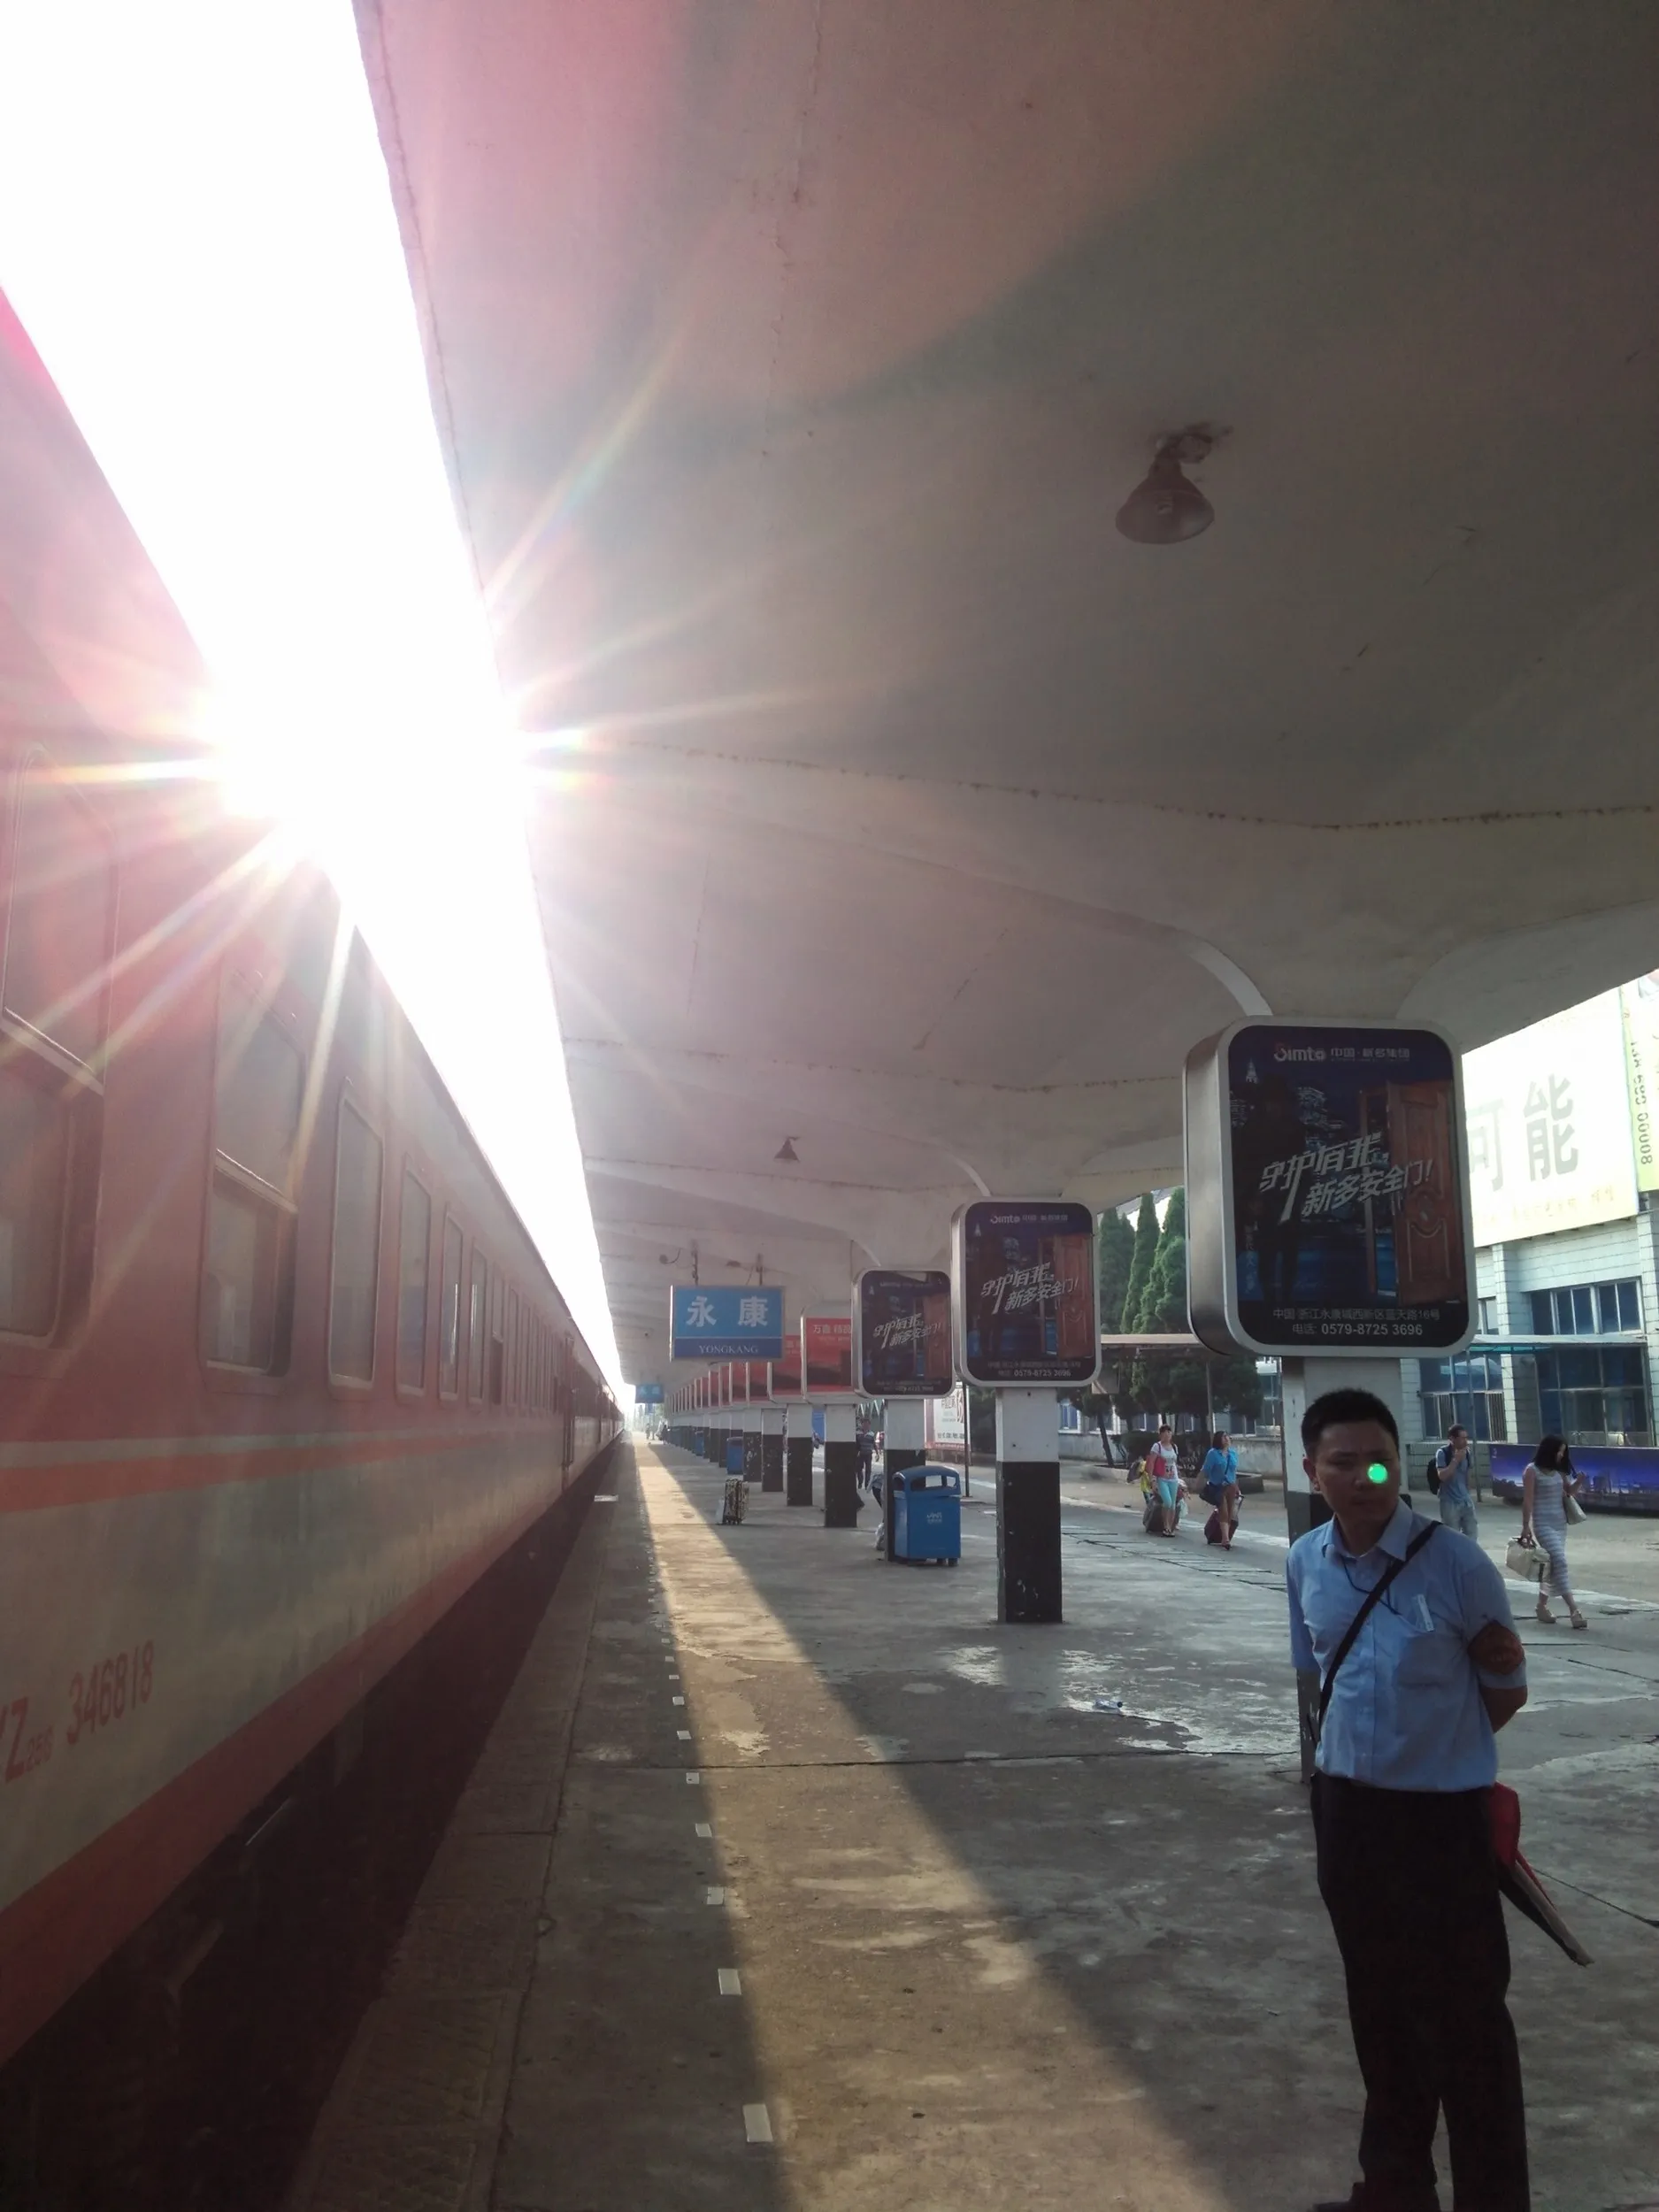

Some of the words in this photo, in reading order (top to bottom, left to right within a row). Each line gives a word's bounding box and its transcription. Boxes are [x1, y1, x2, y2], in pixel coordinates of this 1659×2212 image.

[686, 1295, 769, 1327] 永康
[1392, 1324, 1424, 1336] 3696
[699, 1344, 759, 1355] YONGKANG
[66, 1640, 154, 1746] 346818
